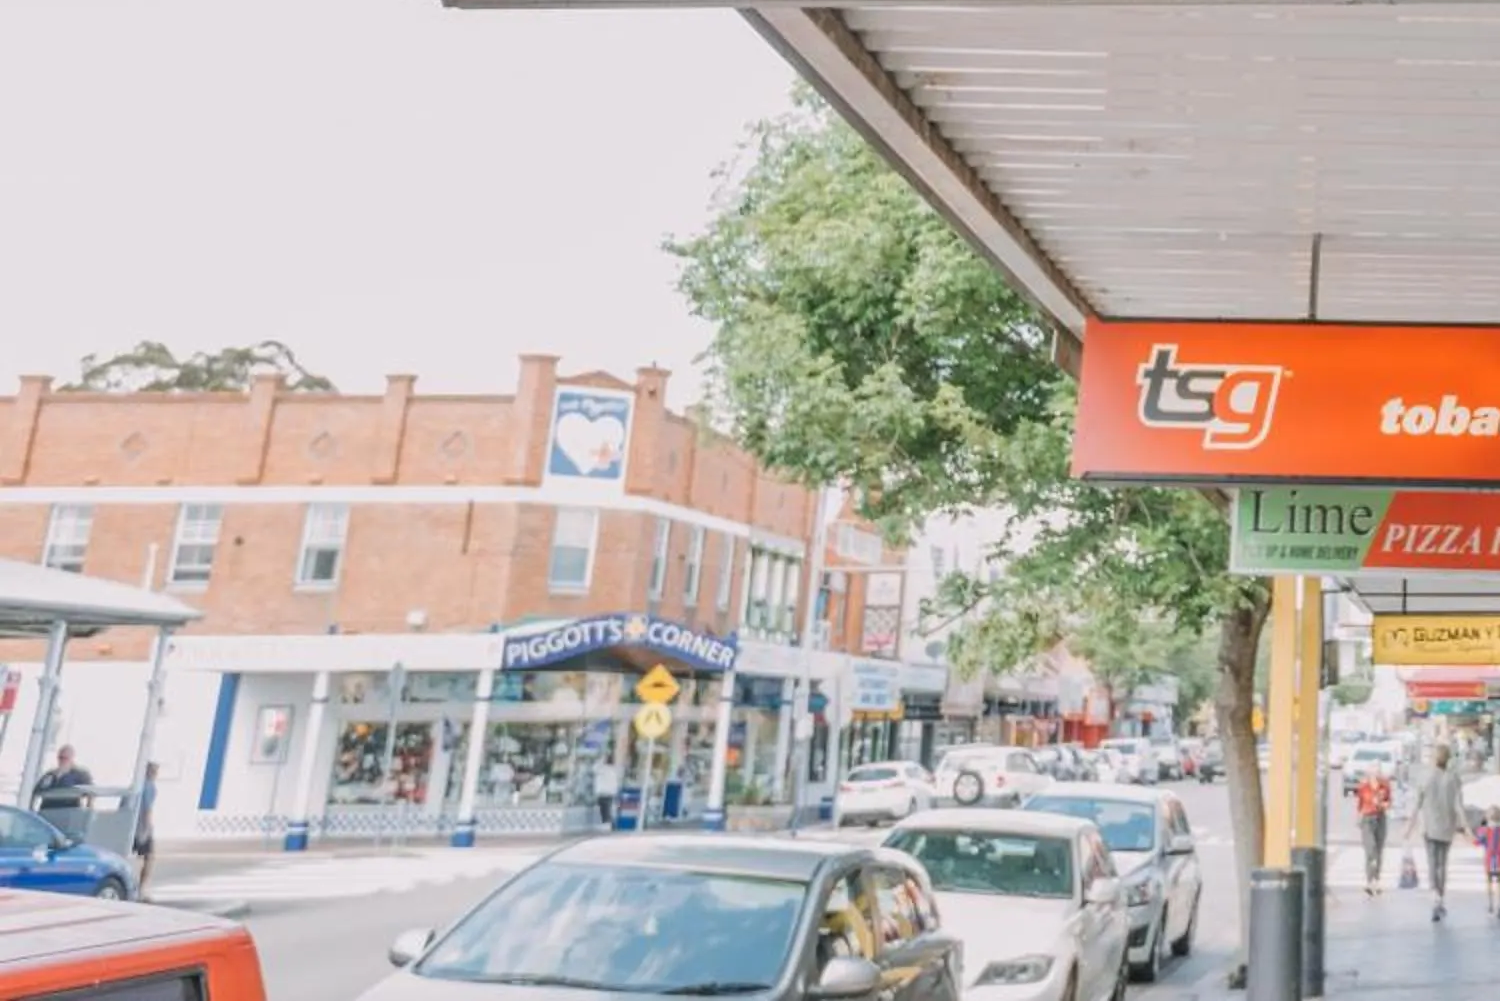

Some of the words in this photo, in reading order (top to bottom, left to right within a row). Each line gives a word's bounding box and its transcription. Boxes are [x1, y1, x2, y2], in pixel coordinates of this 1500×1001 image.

[1136, 343, 1283, 450] tsg
[1252, 490, 1374, 536] Lime
[1382, 523, 1481, 554] PIZZA
[647, 621, 736, 667] CORNER
[1413, 627, 1480, 643] GUZMAN
